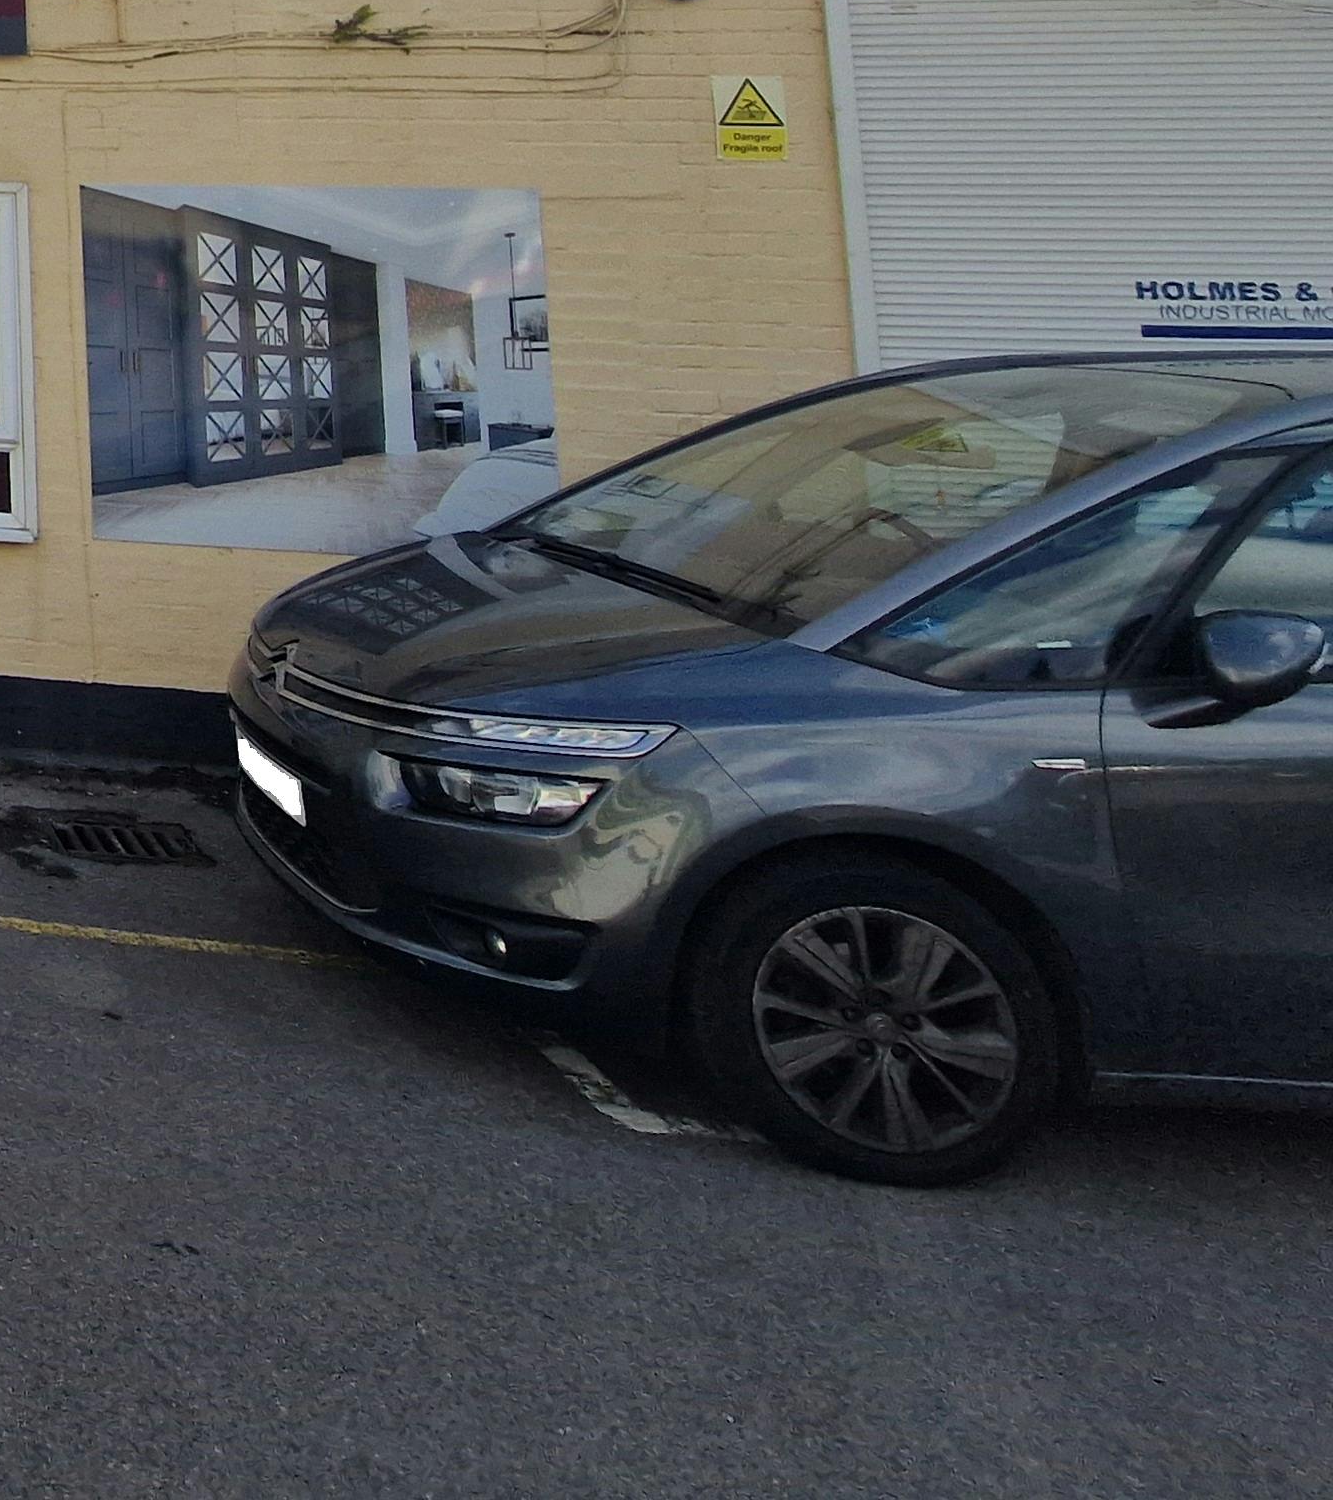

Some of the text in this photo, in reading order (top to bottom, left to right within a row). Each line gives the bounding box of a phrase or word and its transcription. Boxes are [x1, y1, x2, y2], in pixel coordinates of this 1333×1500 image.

[733, 132, 772, 143] Danger
[723, 143, 783, 154] Fragile roof
[1135, 281, 1318, 301] HOLMES &
[1159, 304, 1296, 321] INDUSTRIAL
